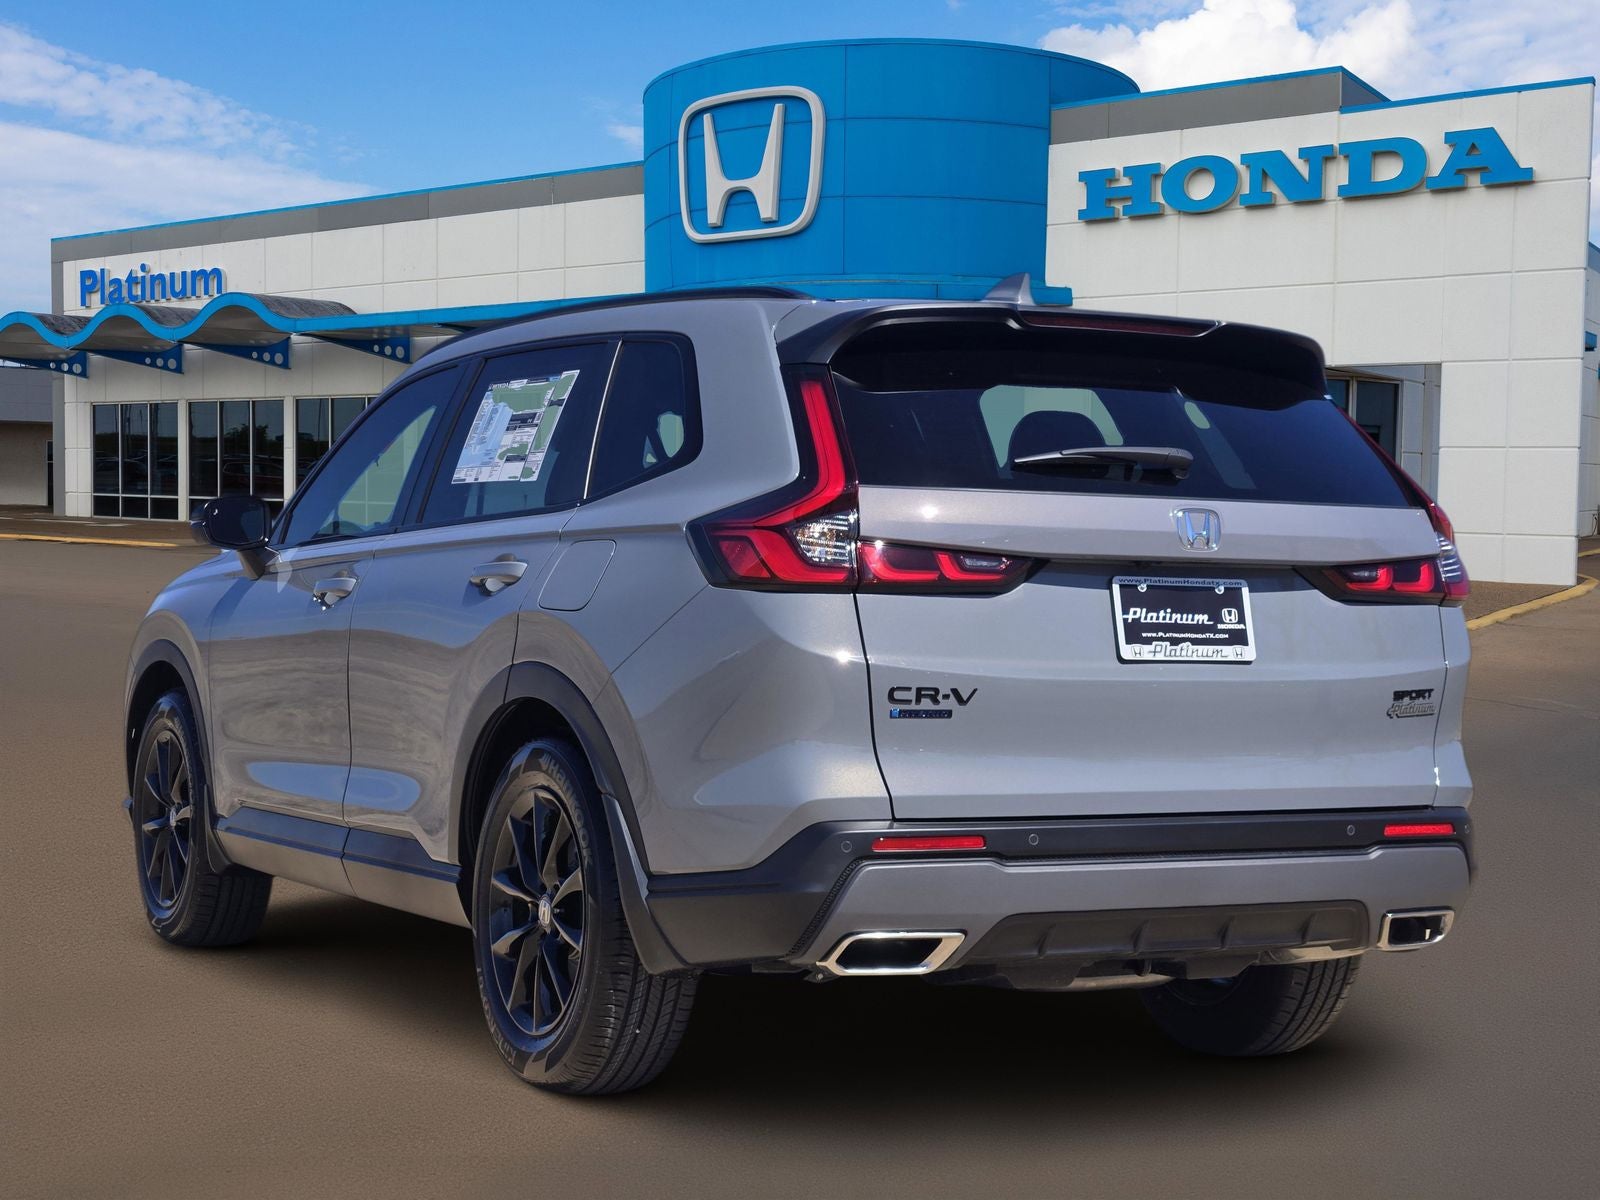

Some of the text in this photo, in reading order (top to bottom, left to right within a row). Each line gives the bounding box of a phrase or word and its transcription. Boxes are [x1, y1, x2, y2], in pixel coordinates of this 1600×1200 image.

[1078, 127, 1534, 222] HONDA
[79, 263, 225, 307] Platinum
[1122, 607, 1213, 625] Platinum
[1148, 642, 1229, 658] Platinum
[887, 686, 979, 707] CR-V
